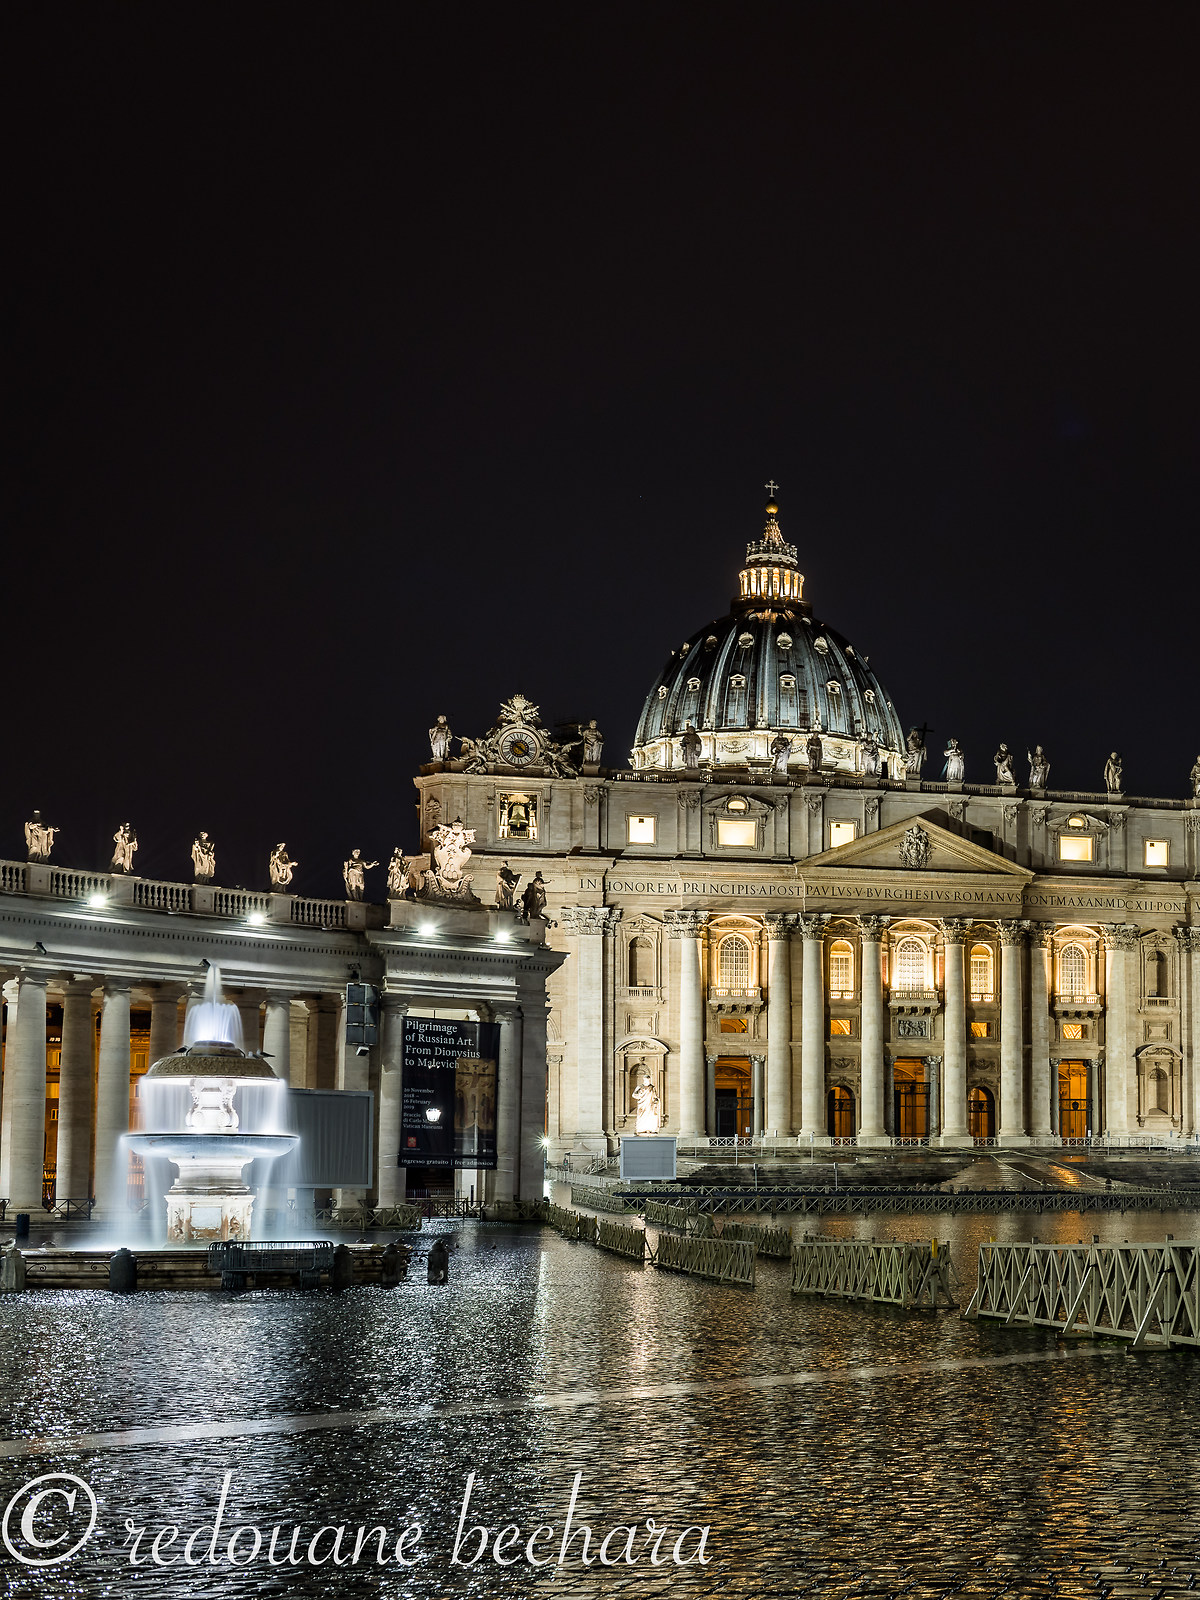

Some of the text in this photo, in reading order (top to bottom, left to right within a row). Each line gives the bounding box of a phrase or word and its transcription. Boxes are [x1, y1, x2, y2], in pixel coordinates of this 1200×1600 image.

[580, 878, 597, 889] IN
[683, 882, 756, 895] PRINCIPIS
[759, 885, 802, 896] APOST
[806, 885, 852, 897] PAVLVS
[866, 887, 950, 901] BVRGHESIVS
[954, 891, 1021, 903] ROMANVS
[1057, 896, 1083, 907] MAX
[1106, 898, 1153, 911] MDCXII
[1157, 901, 1188, 912] PONT
[406, 1020, 458, 1035] Pilgrimage
[405, 1034, 475, 1046] of Russian Art.
[405, 1045, 481, 1059] From Dionysius
[404, 1058, 460, 1069] to Malevich
